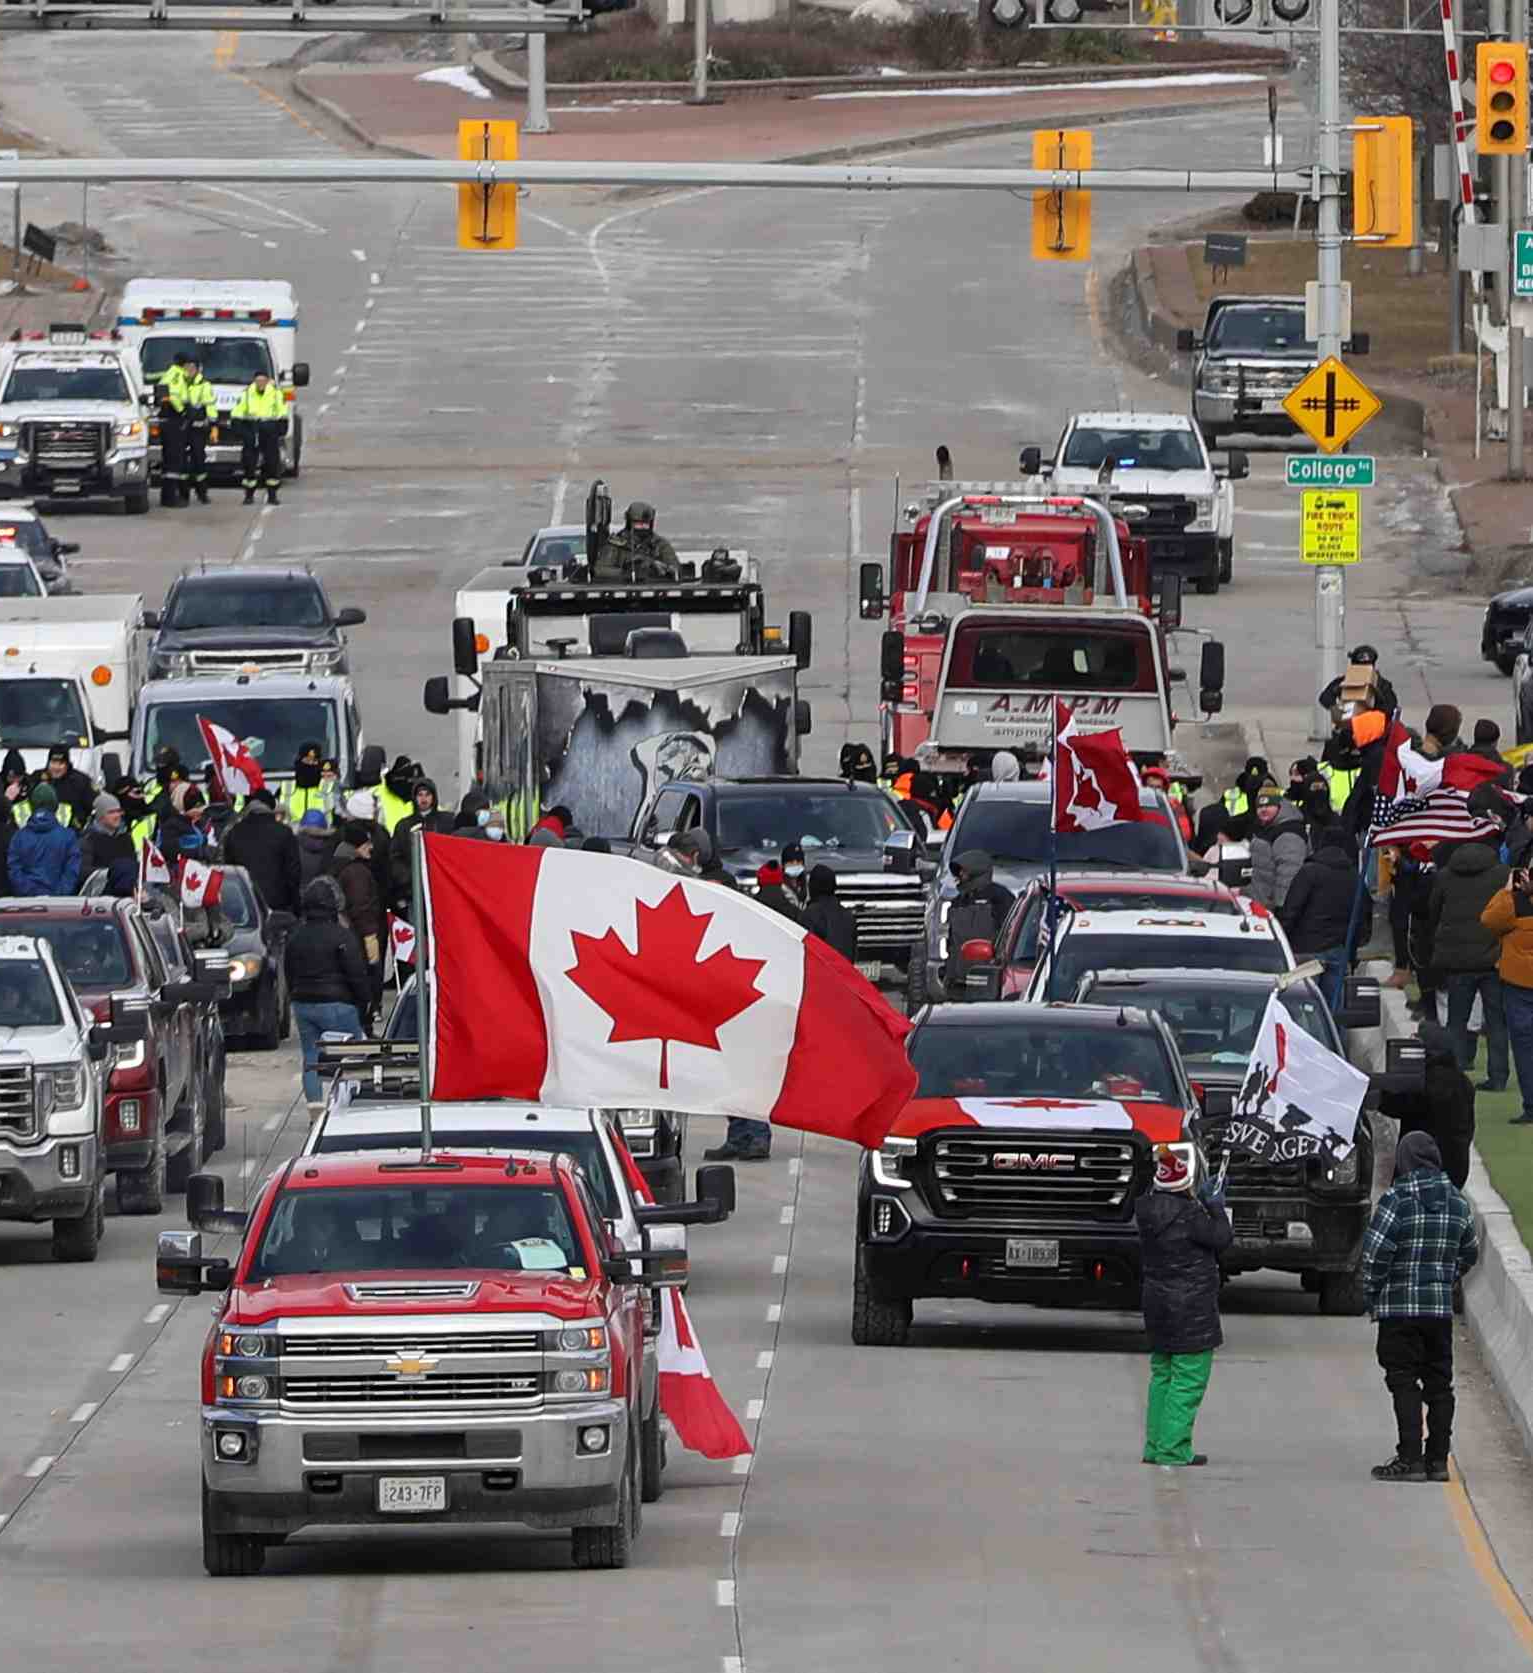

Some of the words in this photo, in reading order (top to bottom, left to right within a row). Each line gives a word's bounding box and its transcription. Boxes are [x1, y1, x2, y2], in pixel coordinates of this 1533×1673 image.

[1289, 460, 1356, 484] College
[1306, 512, 1324, 520] FIRE
[1328, 512, 1355, 520] TRUCK
[993, 1152, 1075, 1170] GMC
